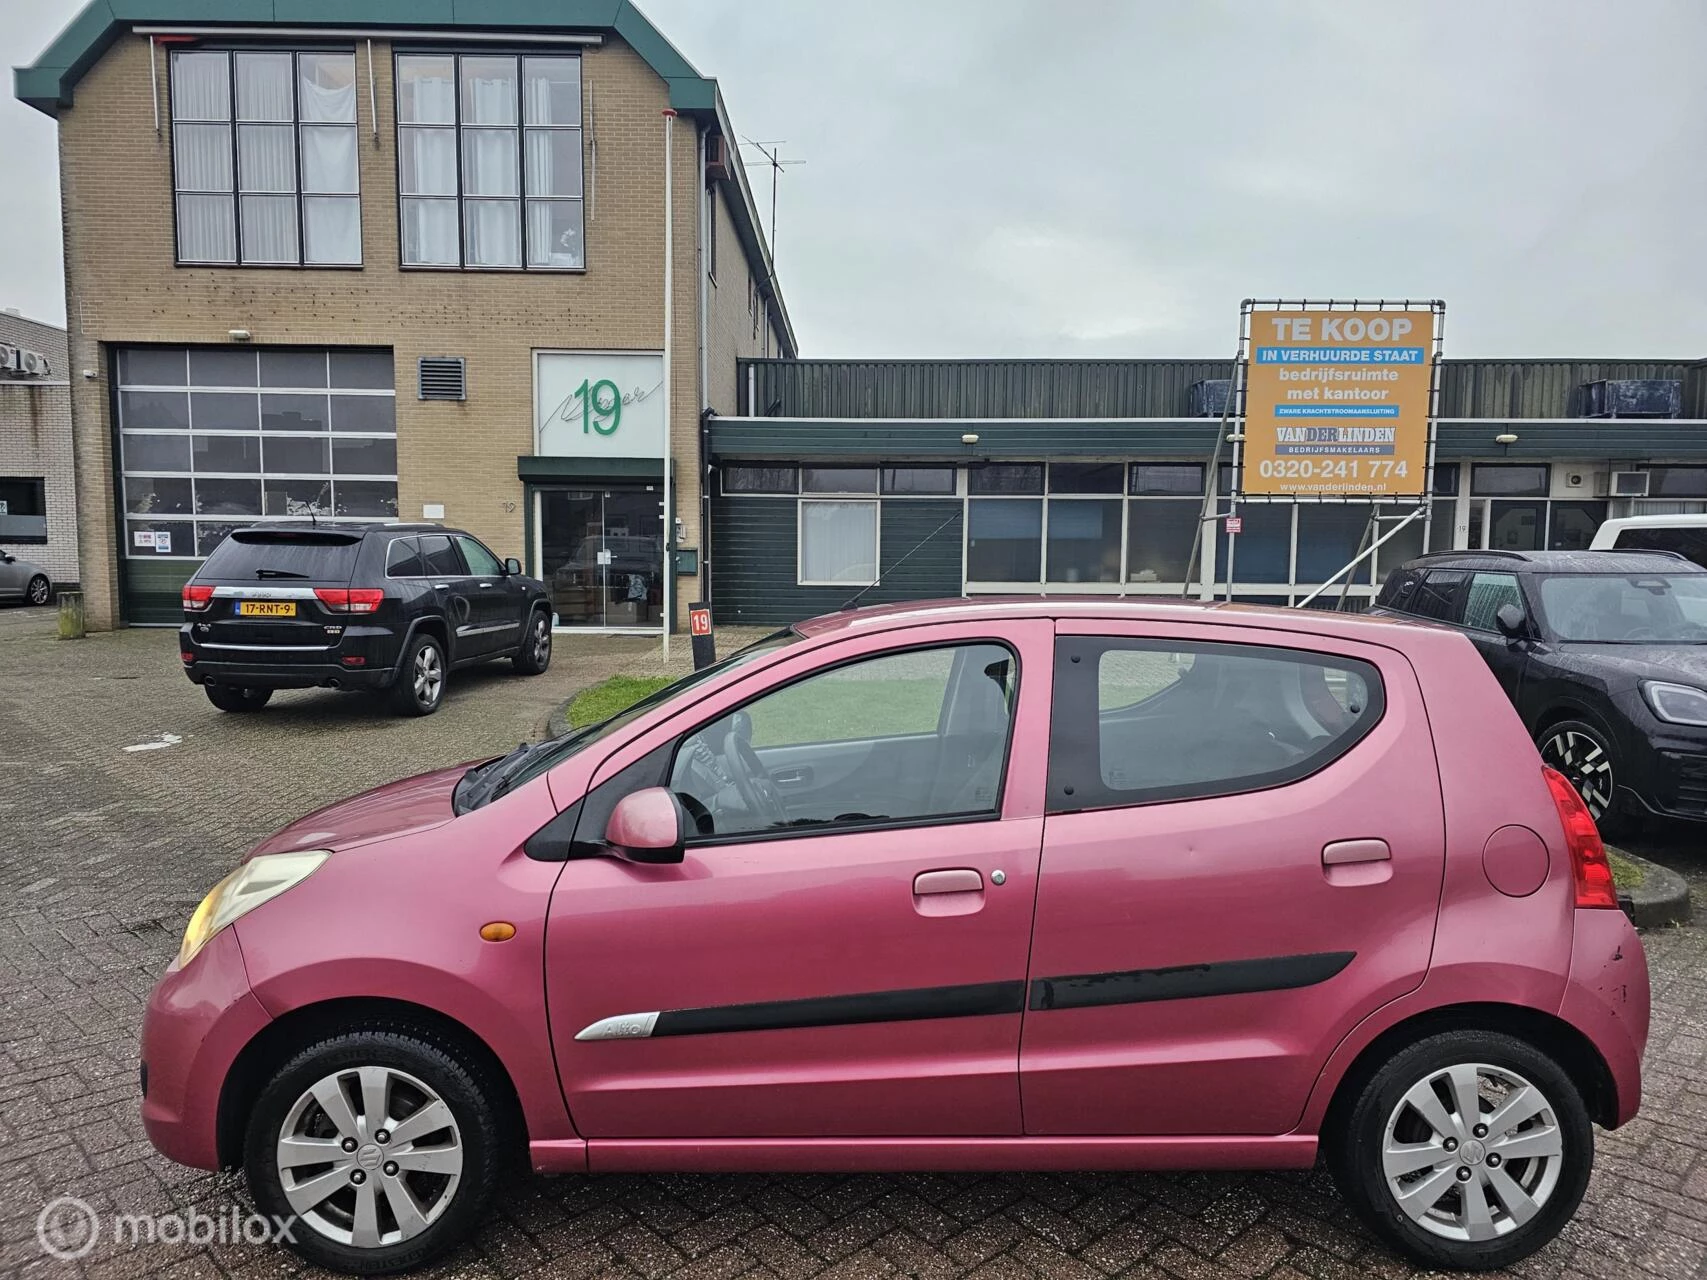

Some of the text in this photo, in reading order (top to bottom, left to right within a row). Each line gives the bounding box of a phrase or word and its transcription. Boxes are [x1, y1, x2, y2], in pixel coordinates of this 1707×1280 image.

[1271, 317, 1413, 342] TE KOOP
[1262, 350, 1419, 362] IN VERHUURDE STAAT
[1279, 367, 1399, 383] bedrijfsruimte
[1287, 386, 1389, 400] met kantoor
[574, 379, 621, 435] 19
[1276, 427, 1396, 442] VANDERLINDEN
[1288, 446, 1381, 454] BEDRIJFSMAKELAARS
[1259, 460, 1408, 479] 0320-241 774
[1280, 483, 1387, 491] www.vanderlinden.nl
[246, 604, 291, 614] 17-RNT-9
[693, 614, 708, 631] 19
